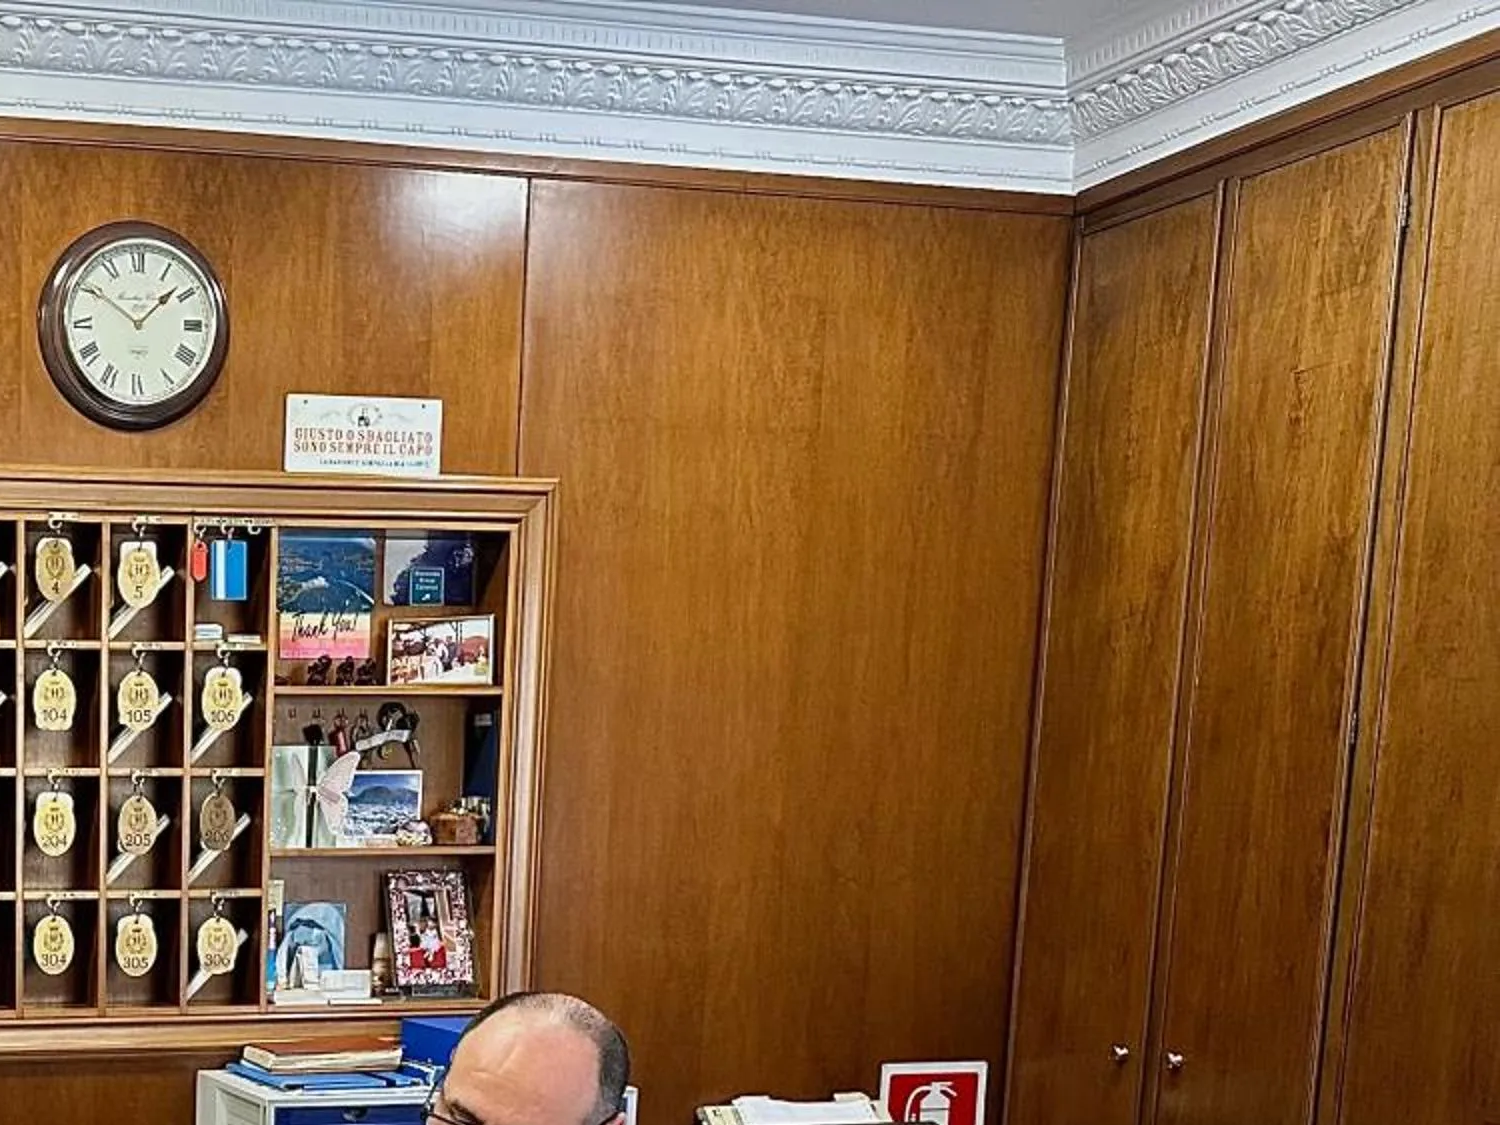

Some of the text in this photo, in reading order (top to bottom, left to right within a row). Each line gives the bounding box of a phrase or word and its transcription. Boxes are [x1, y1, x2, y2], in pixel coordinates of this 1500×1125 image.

[183, 319, 203, 333] III
[294, 427, 343, 441] GIUSTO
[346, 429, 355, 441] O
[293, 440, 434, 457] SONO SEMPRE IL CAPO
[51, 581, 61, 595] 4
[133, 585, 143, 599] 5
[292, 611, 359, 642] Thank You!
[40, 708, 68, 722] 104
[126, 709, 152, 723] 105
[210, 709, 235, 723] 106
[41, 834, 67, 849] 204
[124, 834, 150, 848] 205
[204, 829, 230, 843] 206
[41, 953, 67, 967] 304
[123, 956, 149, 970] 305
[204, 953, 230, 968] 306
